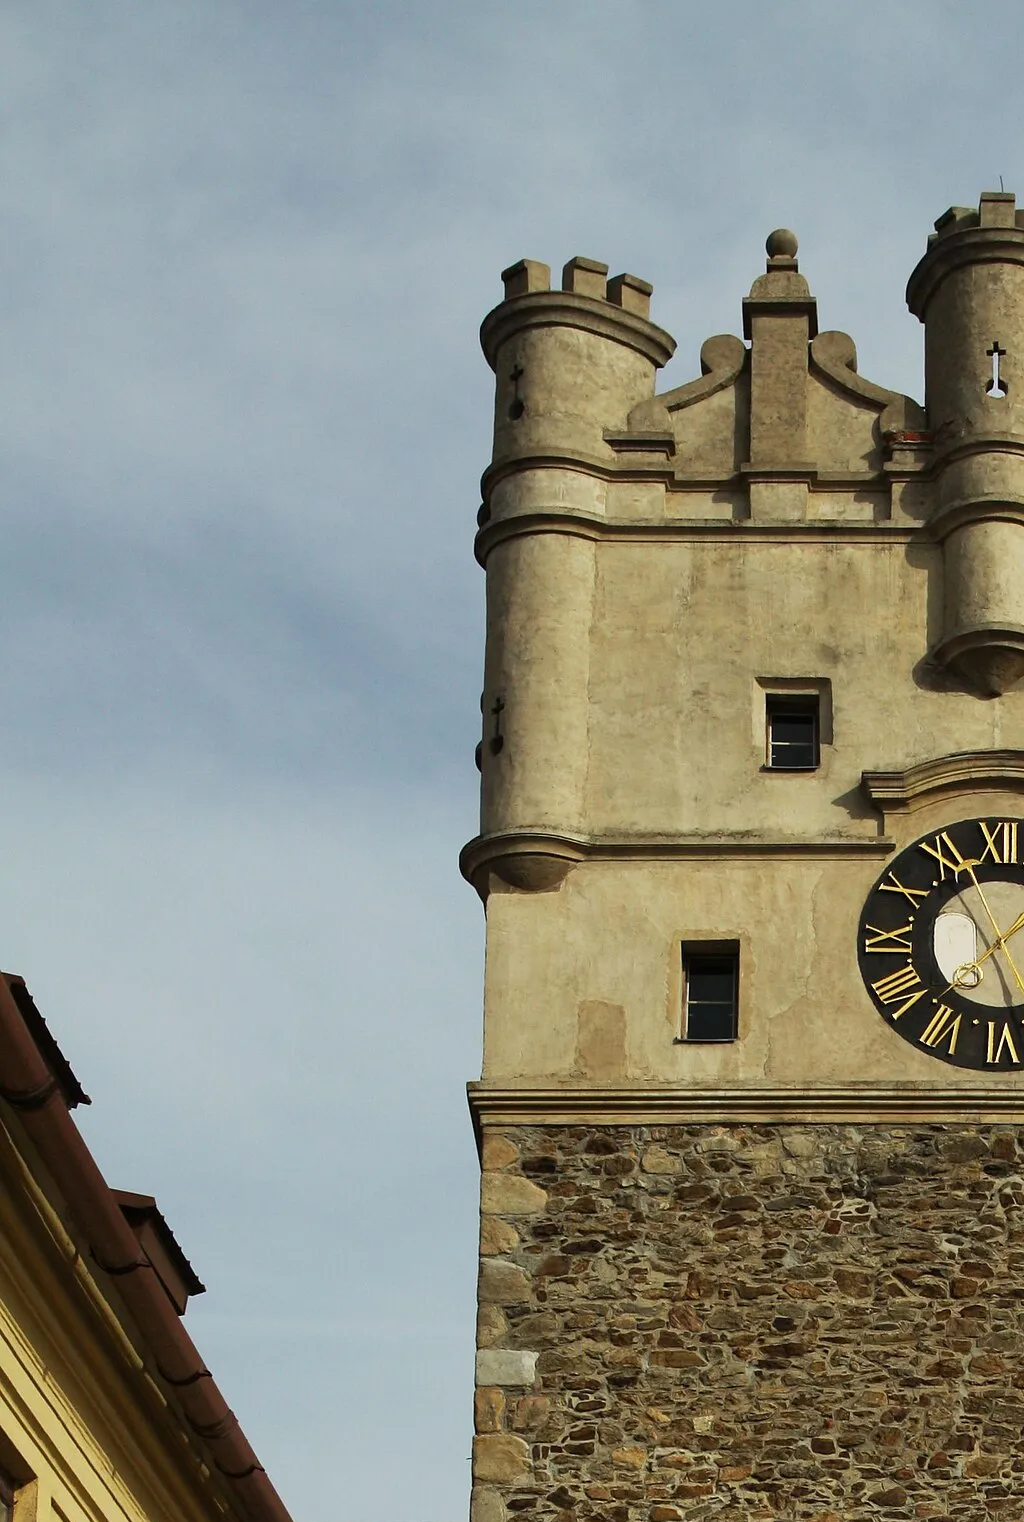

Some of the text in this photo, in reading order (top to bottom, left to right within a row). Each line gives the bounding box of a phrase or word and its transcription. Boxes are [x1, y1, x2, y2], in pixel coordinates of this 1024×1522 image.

[919, 832, 966, 881] XI
[979, 822, 1019, 863] XII
[878, 871, 930, 909] X
[865, 923, 912, 953] IX
[871, 964, 929, 1020] VIII
[919, 1003, 963, 1055] VII
[986, 1021, 1020, 1063] VI
